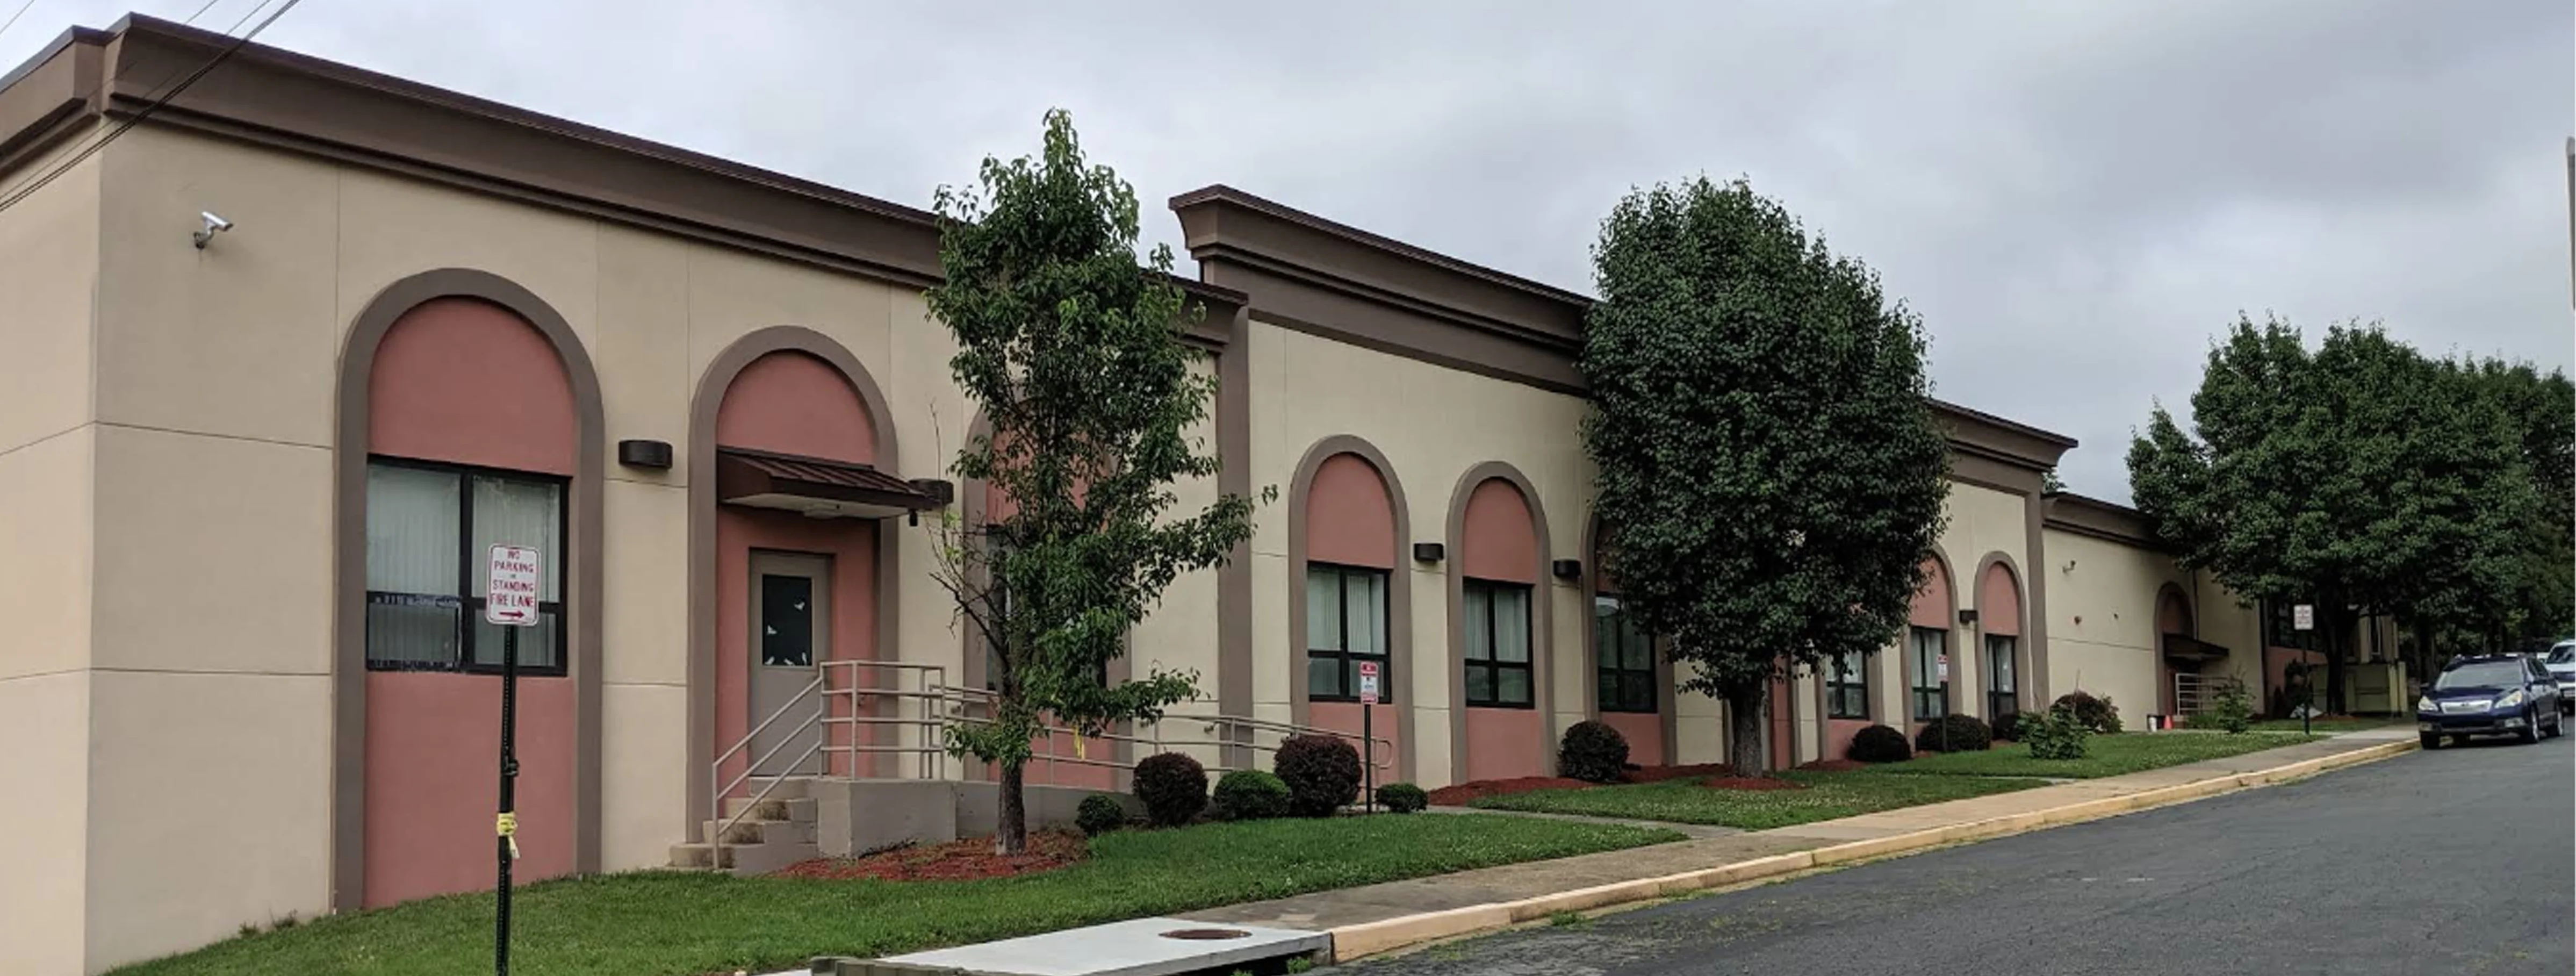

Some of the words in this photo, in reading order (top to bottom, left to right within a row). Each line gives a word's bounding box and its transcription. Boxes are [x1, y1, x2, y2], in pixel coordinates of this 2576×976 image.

[508, 550, 520, 559] NO
[494, 560, 534, 573] PARKING
[493, 579, 534, 592] STANDING
[490, 593, 508, 607] FIRE
[512, 594, 534, 608] LANE
